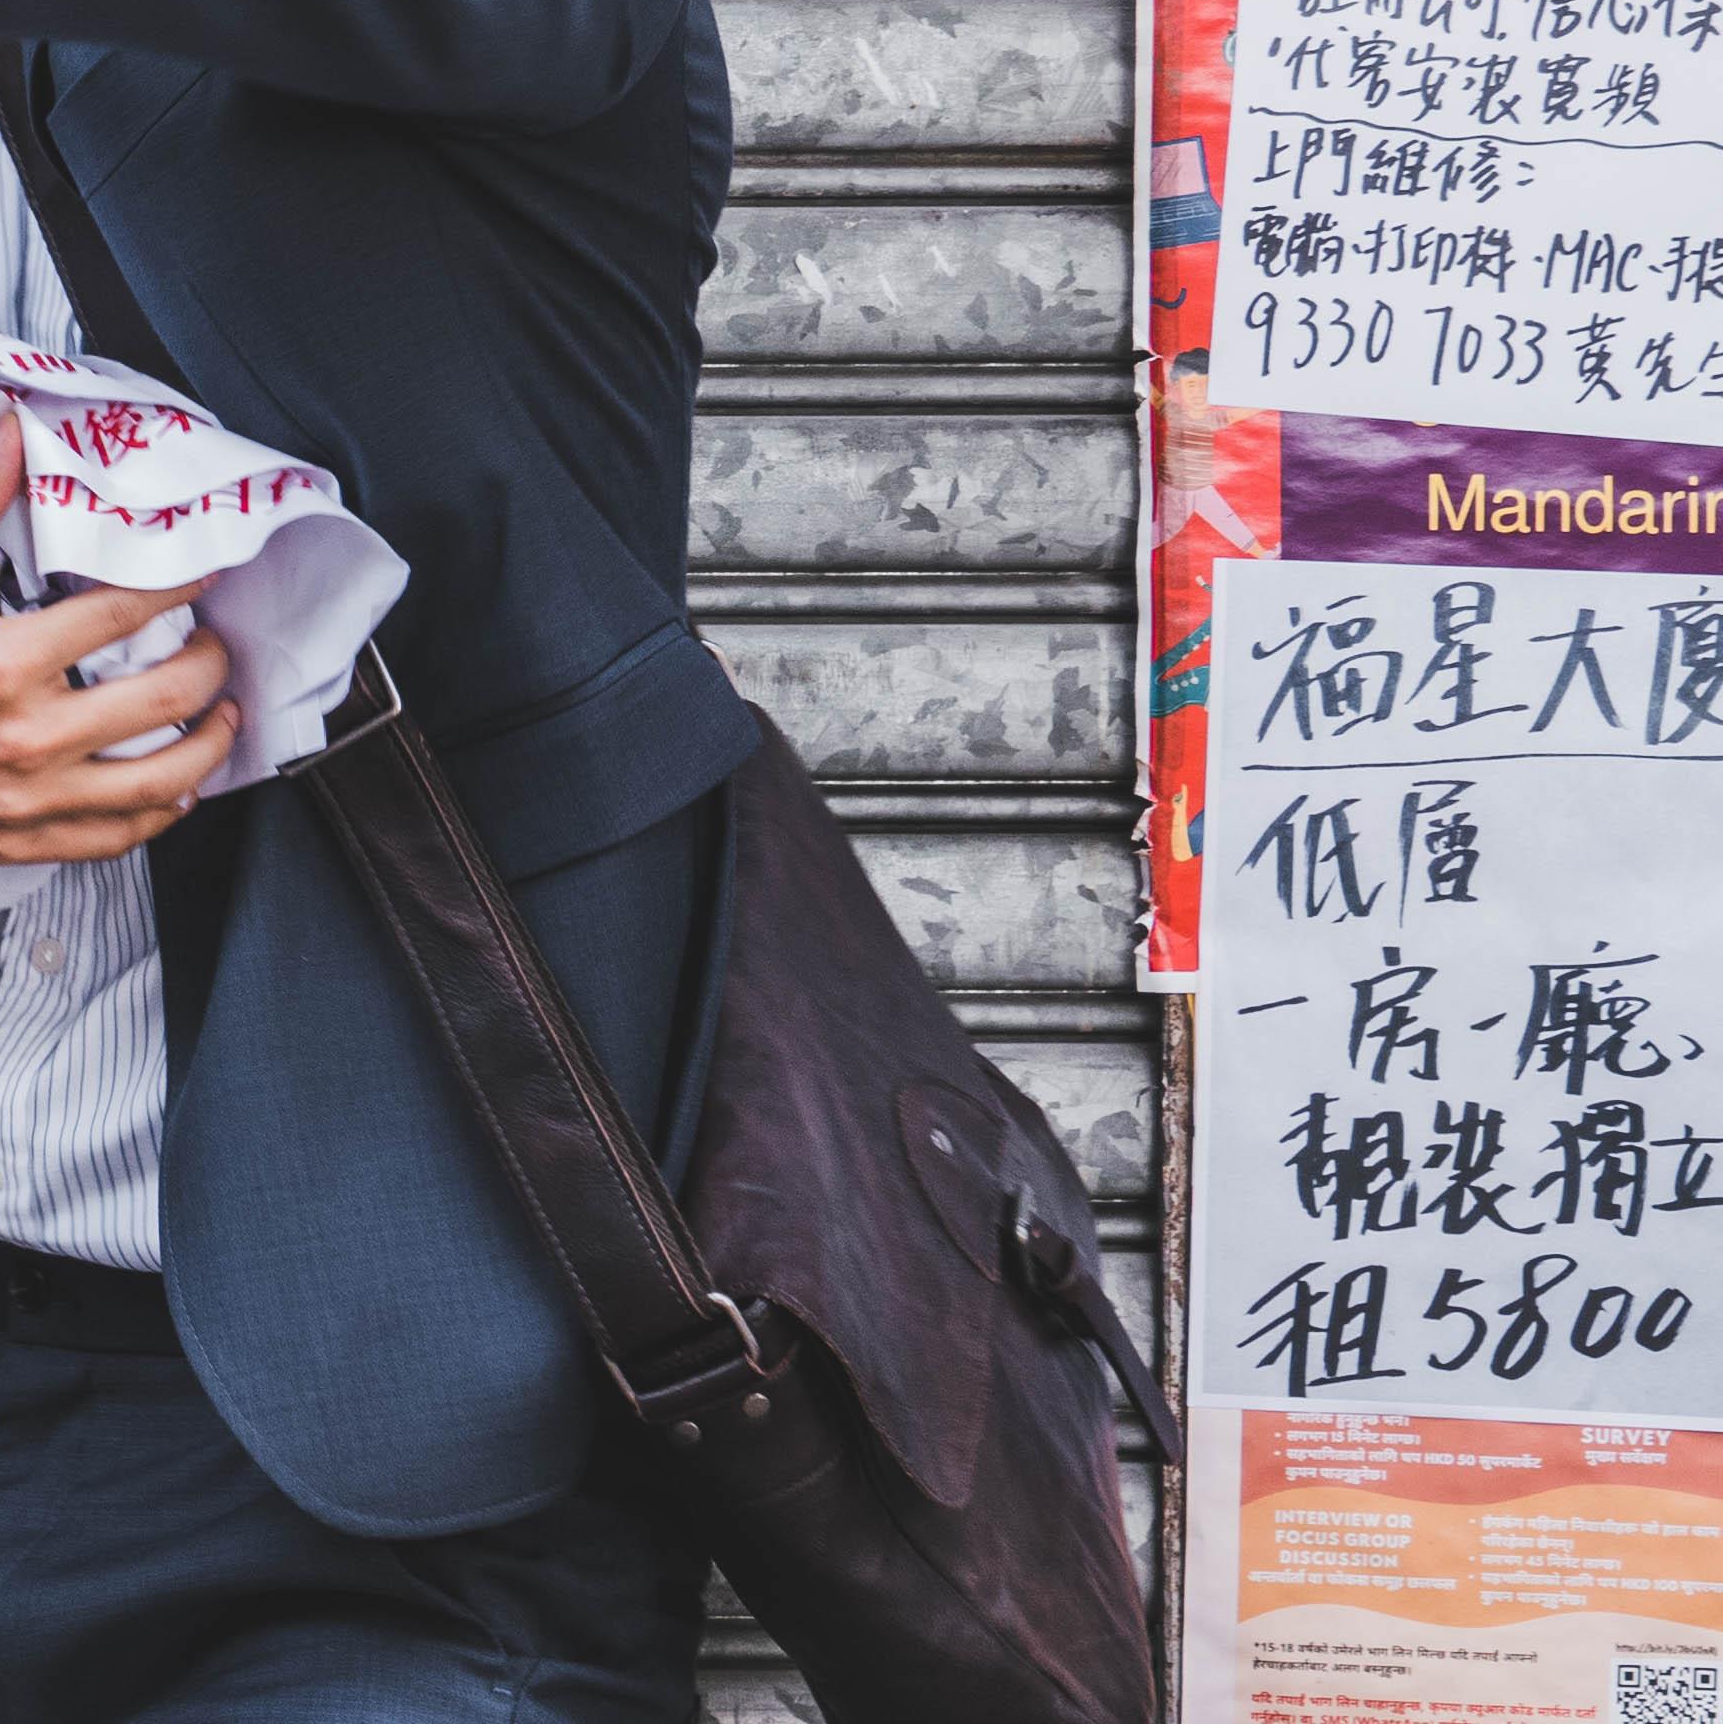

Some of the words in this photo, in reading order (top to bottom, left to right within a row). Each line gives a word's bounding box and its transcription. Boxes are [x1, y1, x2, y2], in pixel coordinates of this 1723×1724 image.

[1244, 290, 1394, 377] 9330
[1423, 305, 1548, 386] 7033
[1235, 779, 1480, 929] 低層
[1581, 1426, 1673, 1447] SURVEY
[1274, 1510, 1380, 1527] INTERVIEW
[1386, 1514, 1414, 1529] OR
[1274, 1529, 1340, 1545] FOCUS
[1343, 1532, 1412, 1549] GROUP
[1279, 1549, 1399, 1568] DISCUSSION
